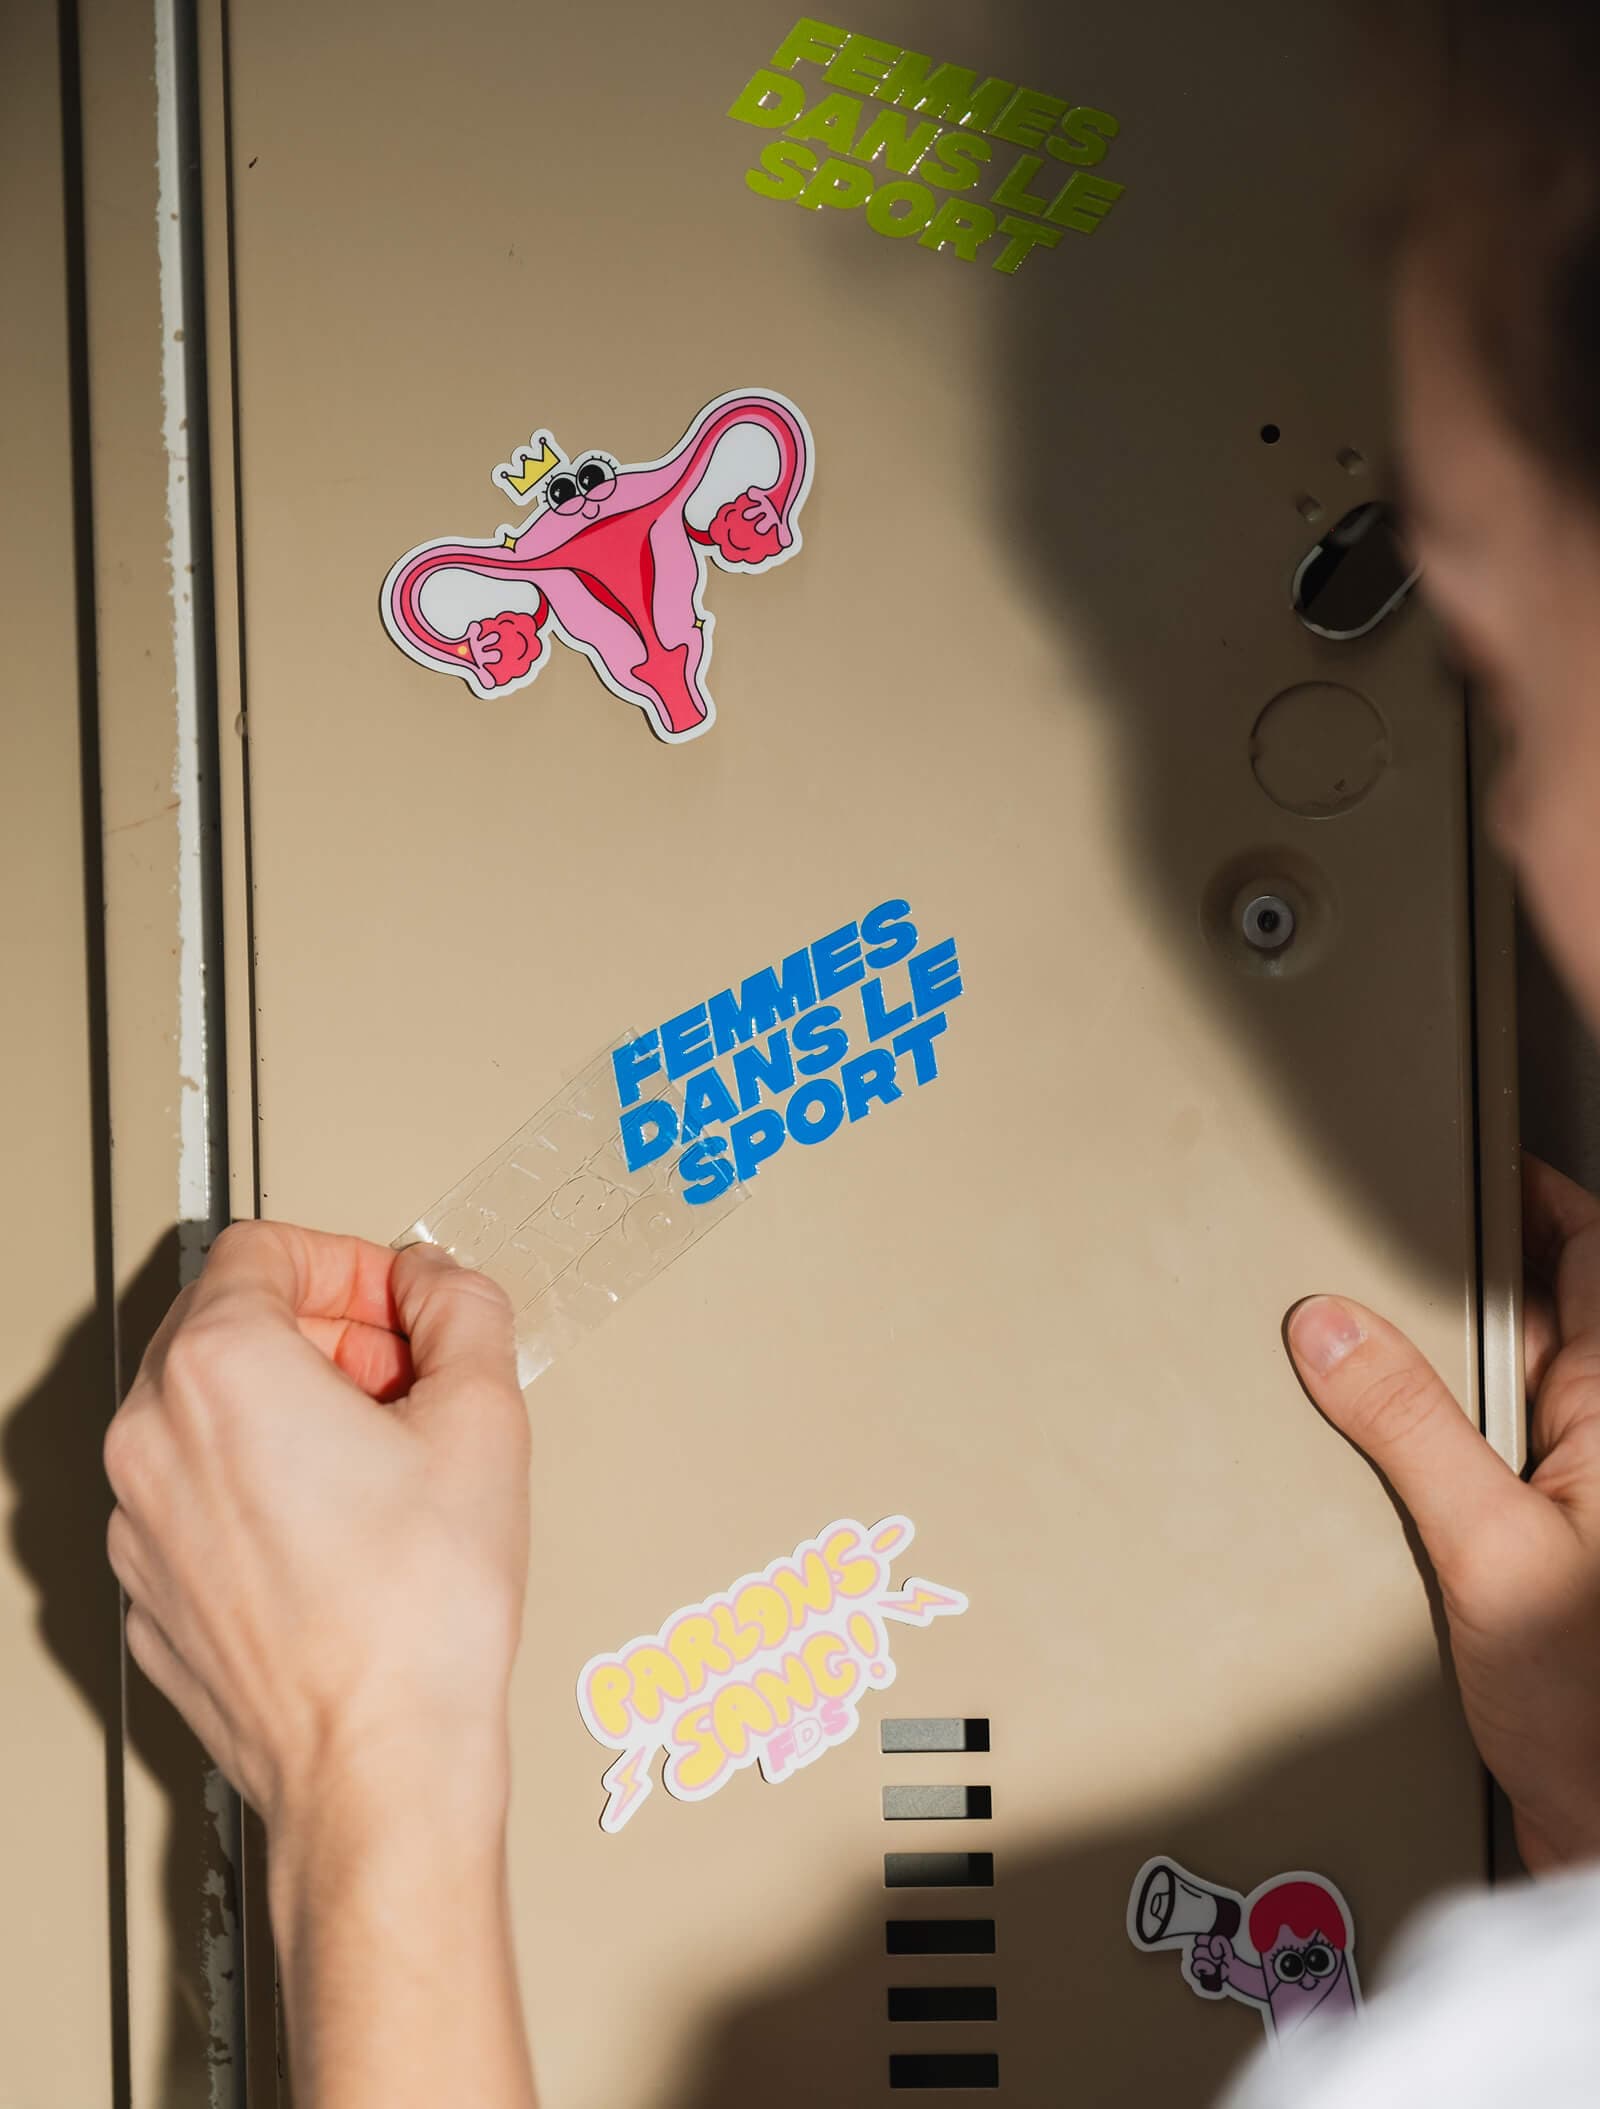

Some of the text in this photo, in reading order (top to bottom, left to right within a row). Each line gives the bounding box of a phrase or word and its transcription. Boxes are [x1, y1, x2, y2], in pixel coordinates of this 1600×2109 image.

[727, 68, 1126, 234] DANS LE
[770, 17, 1120, 166] FEMMES
[745, 140, 1063, 274] SPORT
[612, 898, 918, 1108] FEMMES
[619, 937, 964, 1173] DANS LE
[678, 1011, 947, 1205] SPORT
[672, 1611, 886, 1790] SANG!
[766, 1700, 849, 1772] FDS
